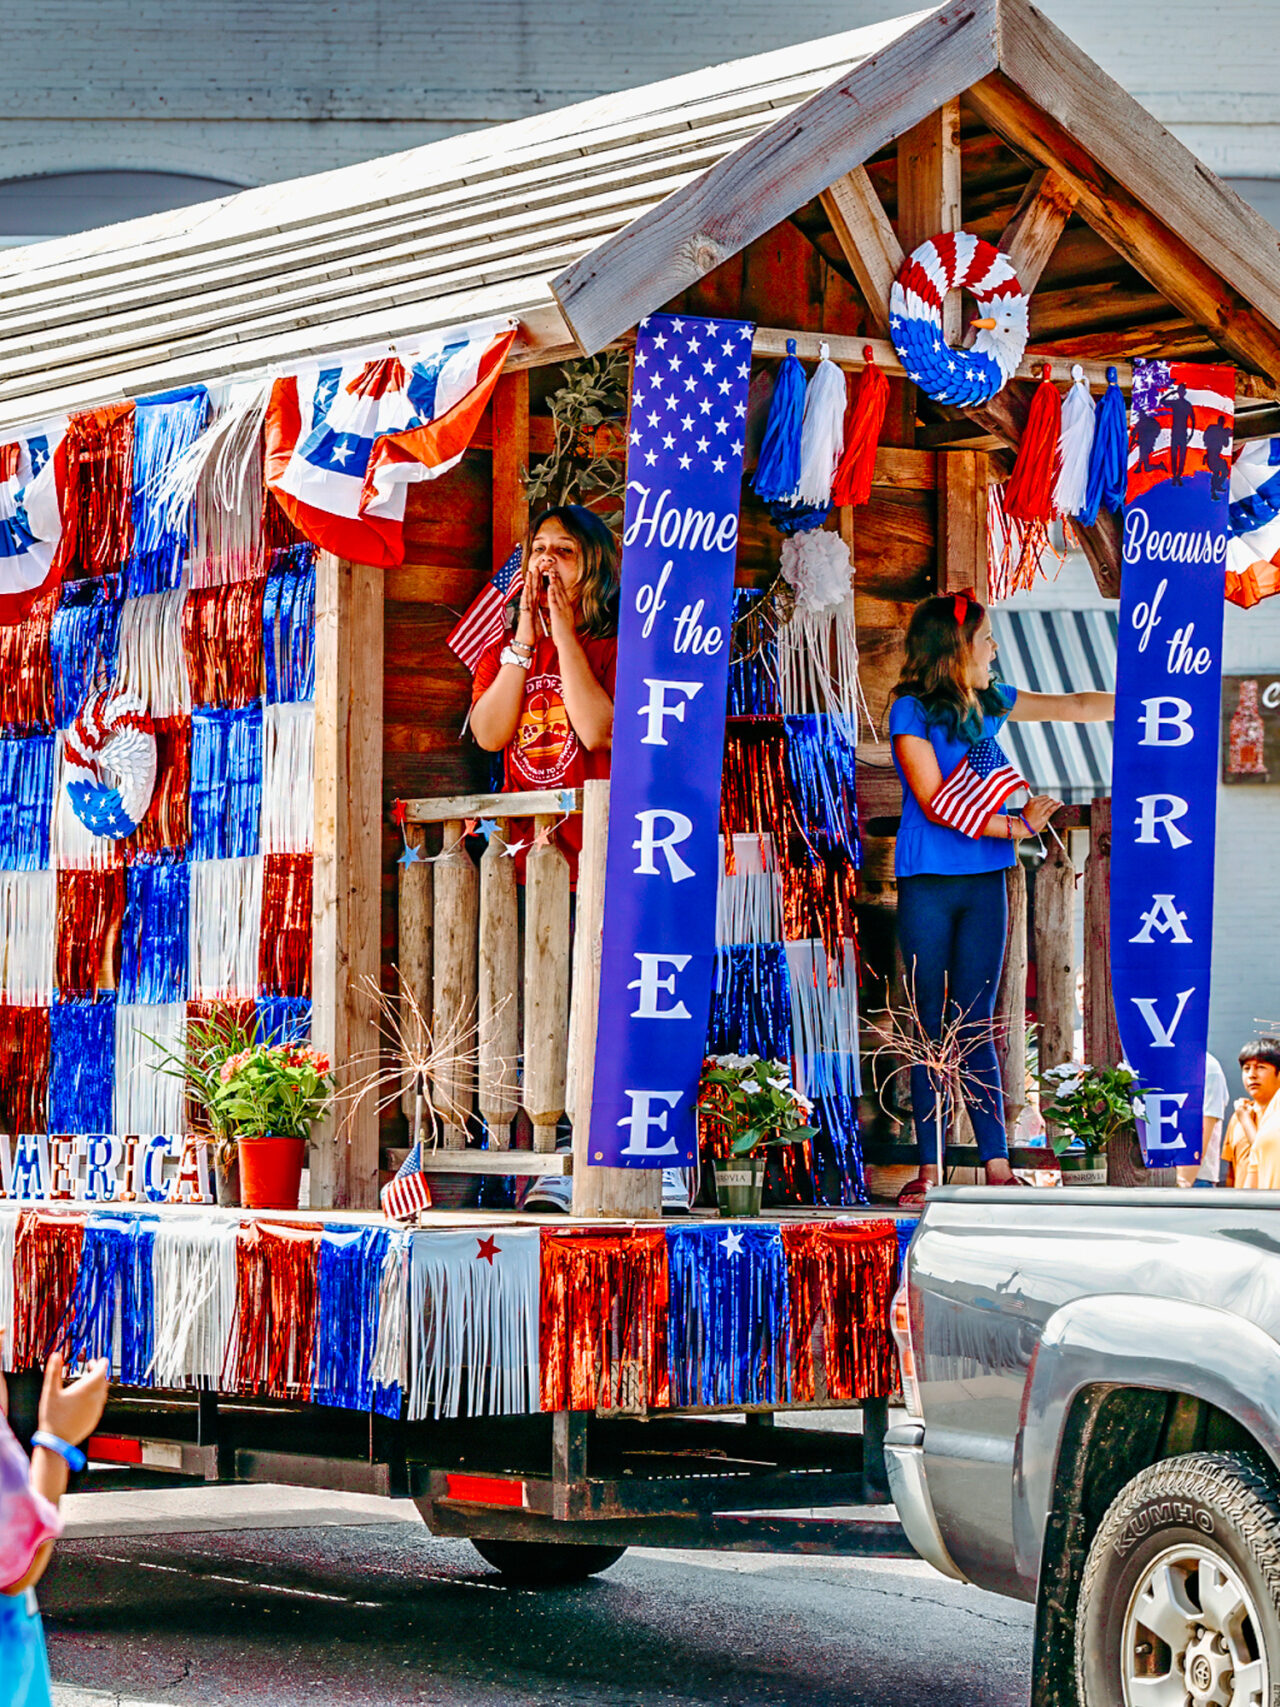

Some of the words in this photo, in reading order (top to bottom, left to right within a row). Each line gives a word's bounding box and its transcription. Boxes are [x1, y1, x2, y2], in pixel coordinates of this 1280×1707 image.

[623, 480, 738, 552] Home
[1122, 507, 1228, 565] Because
[635, 559, 674, 639] of
[673, 598, 724, 656] the
[1131, 578, 1169, 653] of
[1166, 622, 1212, 675] the
[616, 678, 704, 1156] FREE
[1128, 696, 1196, 1149] BRAVE
[1113, 1502, 1215, 1557] KUMHO
